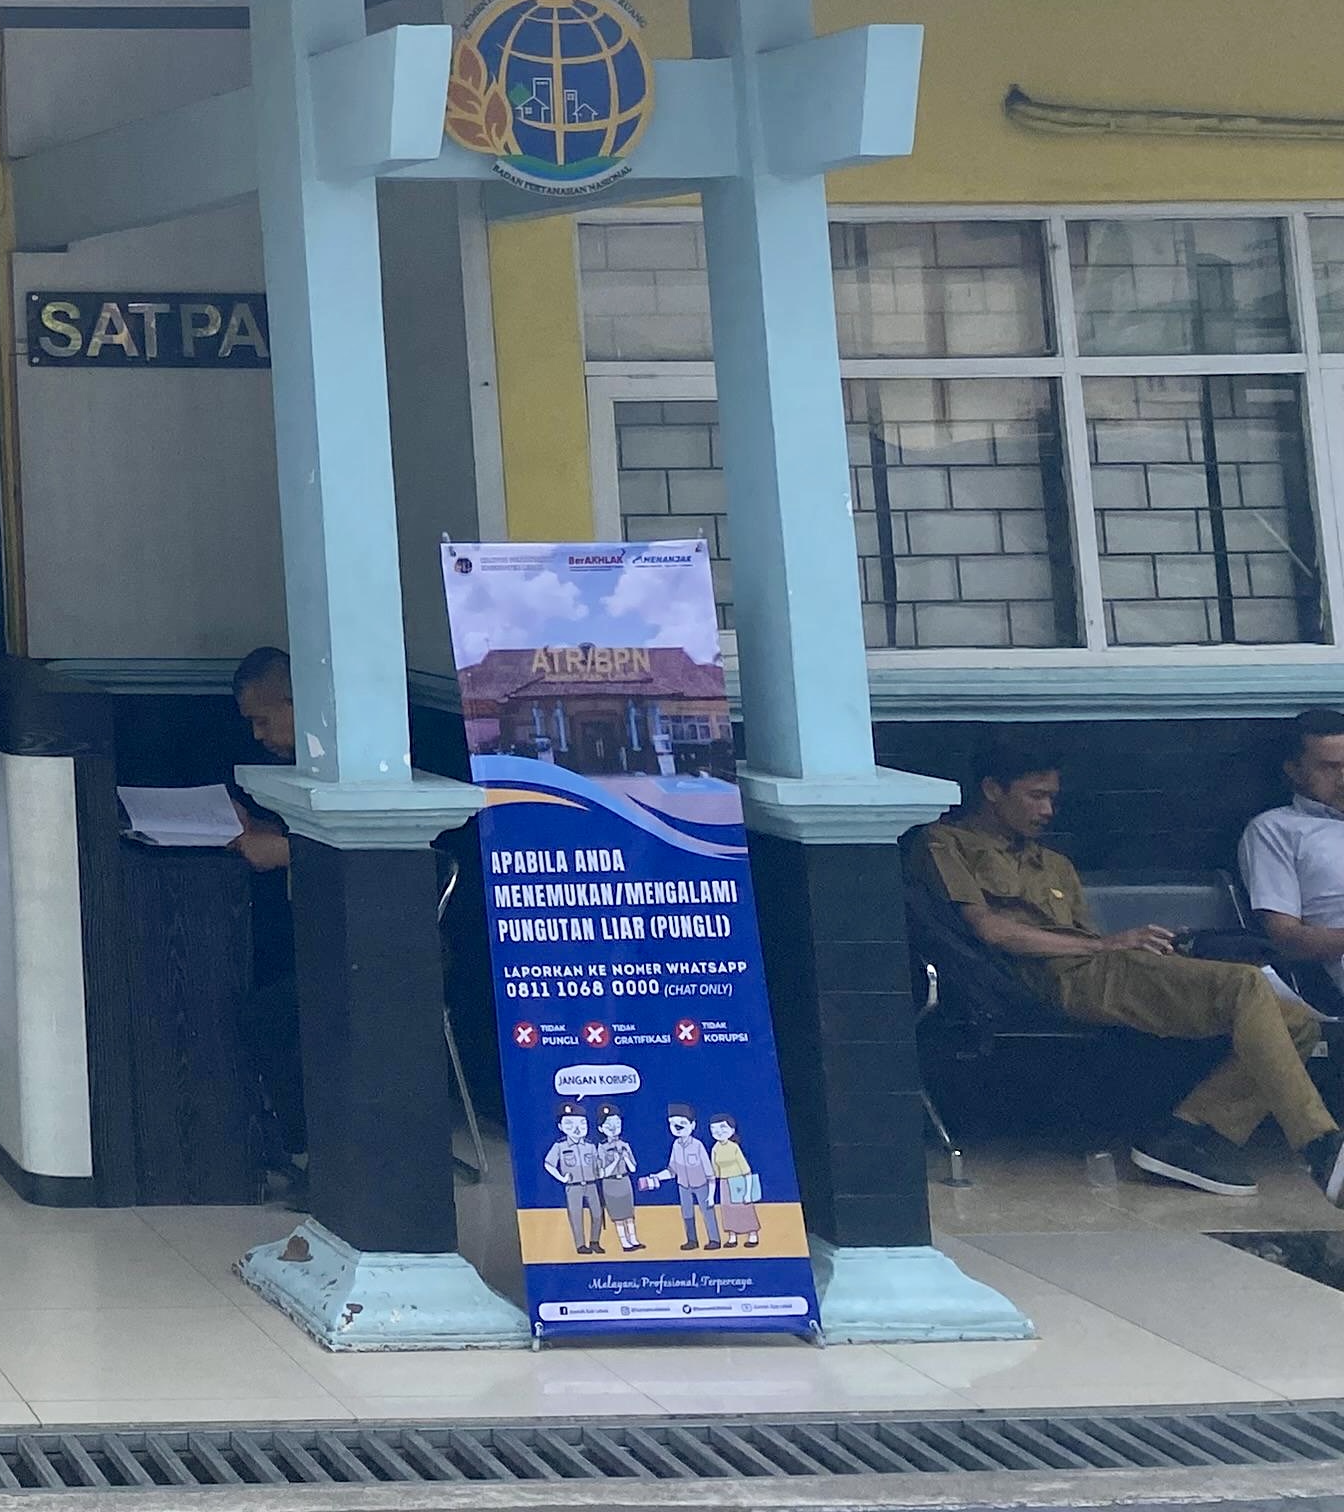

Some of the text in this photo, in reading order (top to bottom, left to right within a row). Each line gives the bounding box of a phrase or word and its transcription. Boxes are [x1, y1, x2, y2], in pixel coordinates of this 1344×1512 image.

[492, 164, 523, 187] BADAN
[589, 166, 632, 193] NASIONAL
[531, 647, 651, 674] ATR/BPN
[491, 849, 626, 874] APABILA ANDA
[494, 880, 738, 908] MENEMUKAN/MENGALAMI
[498, 914, 731, 942] PUNGUTAN LIAR (PUNGLI)
[503, 964, 584, 979] LAPORKAN
[588, 964, 607, 977] KE
[665, 961, 748, 975] WHATSAPP
[506, 979, 733, 998] 0811 1068 0000 (CHAT ONLY)
[540, 1021, 727, 1032] TIDAK TIDAK TIDAK
[542, 1032, 749, 1046] PUNGLI GRATIFIKASI KORUPSI
[558, 1074, 637, 1087] JANGAN KORUPSI
[588, 1272, 753, 1295] Melayani, Profesional, Terpercaya
